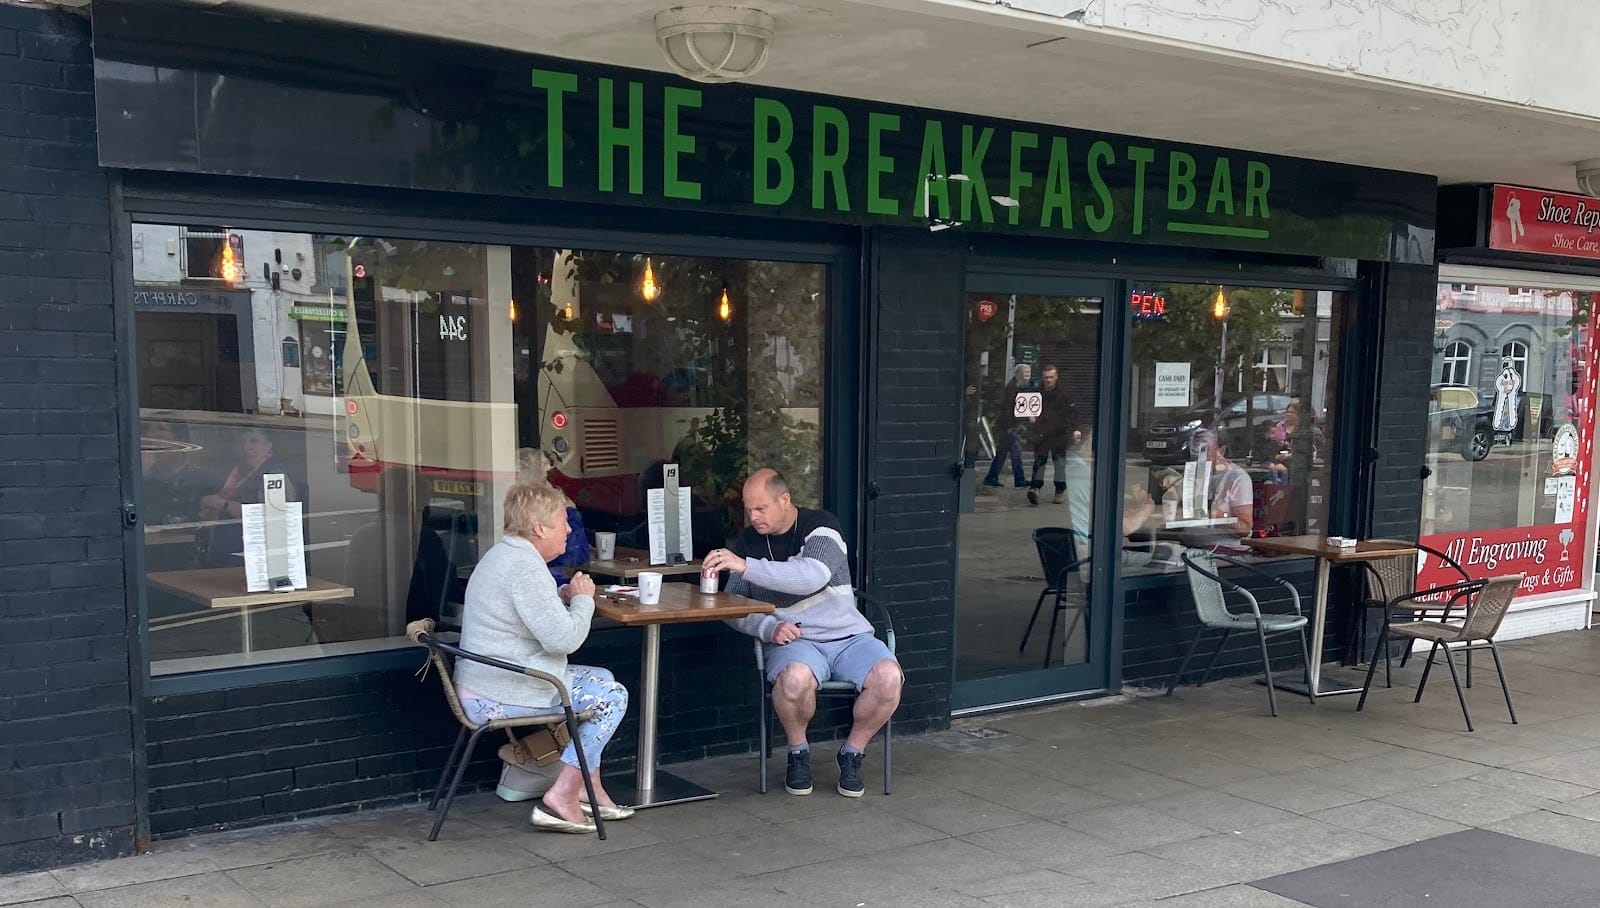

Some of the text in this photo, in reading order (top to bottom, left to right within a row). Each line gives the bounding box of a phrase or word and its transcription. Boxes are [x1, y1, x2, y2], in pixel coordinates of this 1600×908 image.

[531, 68, 1272, 236] THE BREAKFAST BAR
[1537, 196, 1571, 223] Shoe
[1552, 233, 1599, 254] Shoe Care,
[1131, 294, 1165, 313] PEN
[267, 479, 283, 490] 20
[667, 468, 676, 478] 19
[1438, 534, 1548, 570] All Engraving
[1519, 571, 1540, 592] Tags
[1541, 571, 1551, 586] &
[1553, 565, 1575, 588] Gifts
